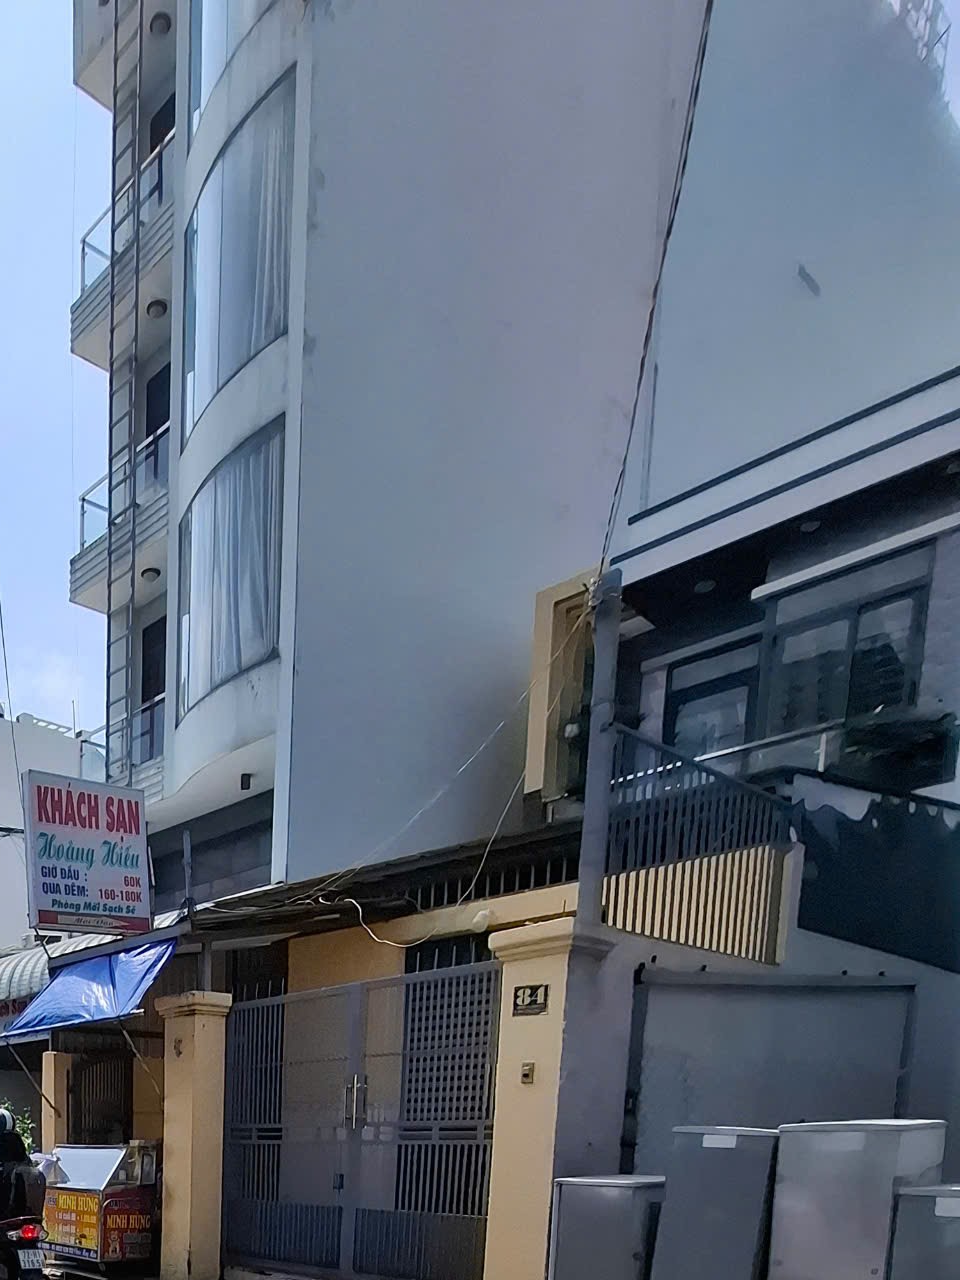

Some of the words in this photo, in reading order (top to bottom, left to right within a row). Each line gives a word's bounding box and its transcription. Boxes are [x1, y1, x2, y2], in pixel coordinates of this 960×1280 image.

[37, 782, 99, 829] KHÁCH
[106, 796, 140, 842] SẠN
[37, 832, 95, 871] Hoàng
[41, 864, 58, 879] GIỜ
[123, 875, 142, 889] 60K
[42, 882, 62, 896] QUA
[51, 898, 81, 913] Phòng
[102, 902, 124, 917] Sạch
[516, 986, 545, 1006] 84
